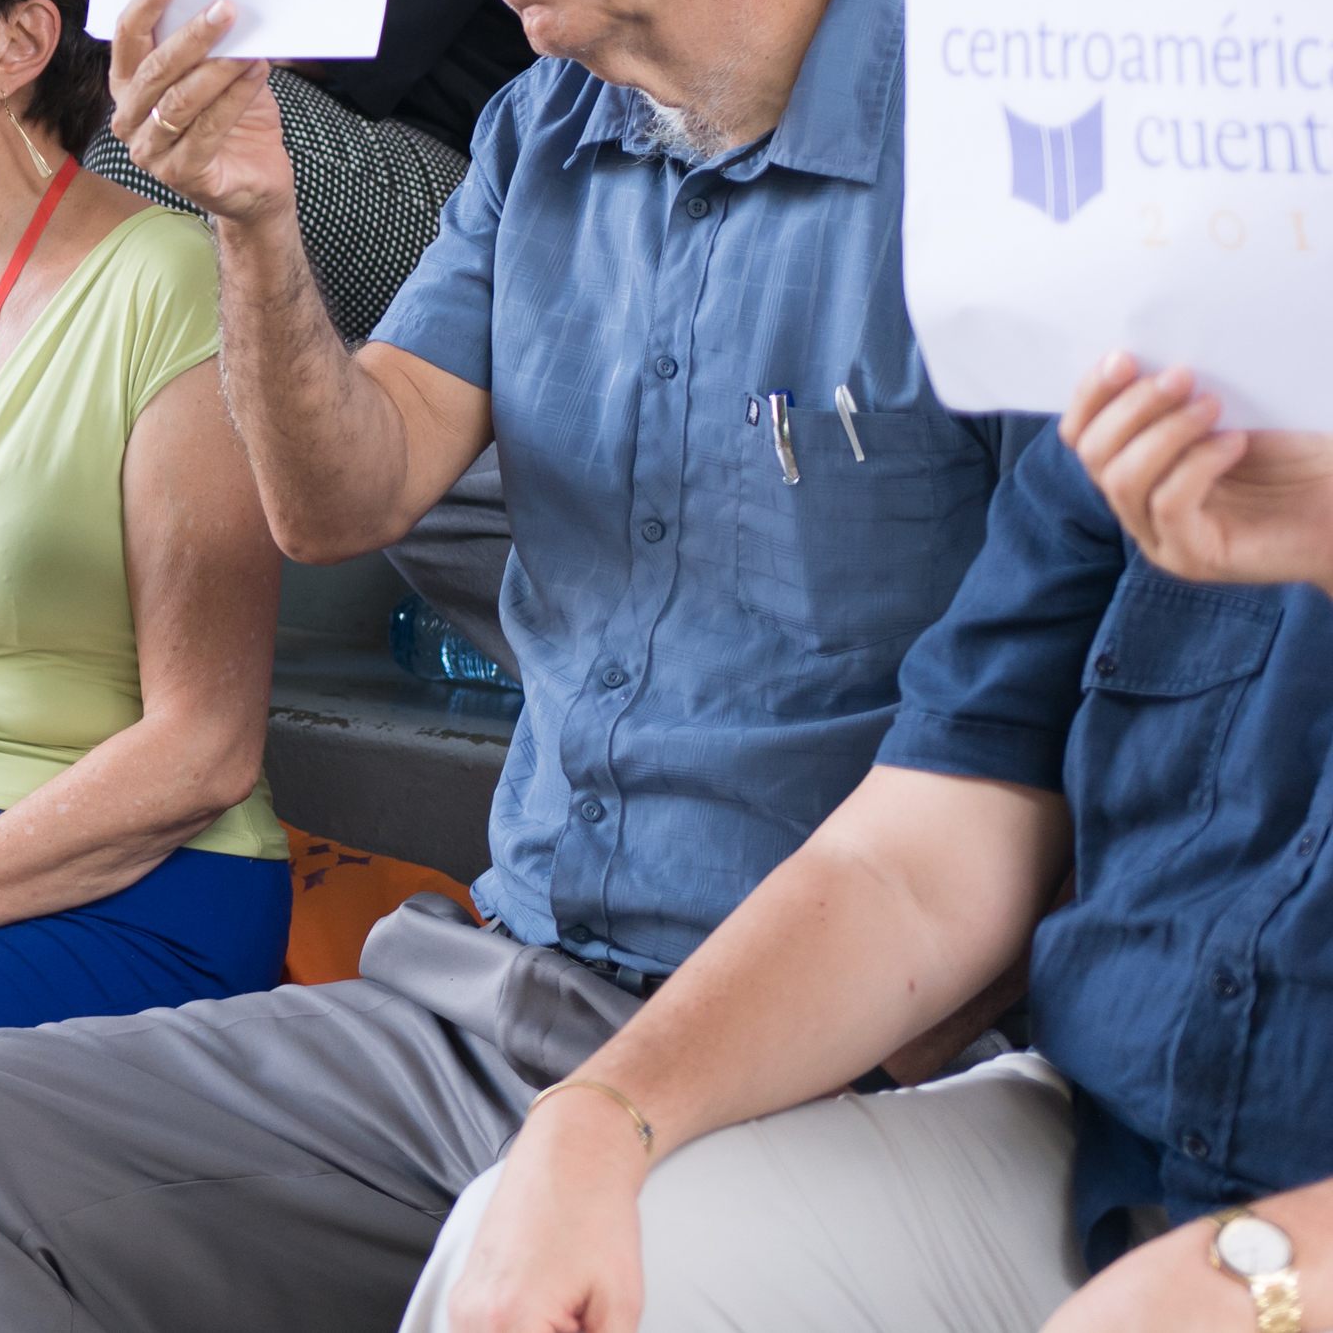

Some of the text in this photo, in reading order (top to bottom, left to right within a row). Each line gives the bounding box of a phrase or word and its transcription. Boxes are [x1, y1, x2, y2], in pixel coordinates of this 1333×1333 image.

[941, 10, 1333, 90] centroaméric
[1134, 111, 1333, 177] cuent
[1138, 203, 1314, 252] 201
